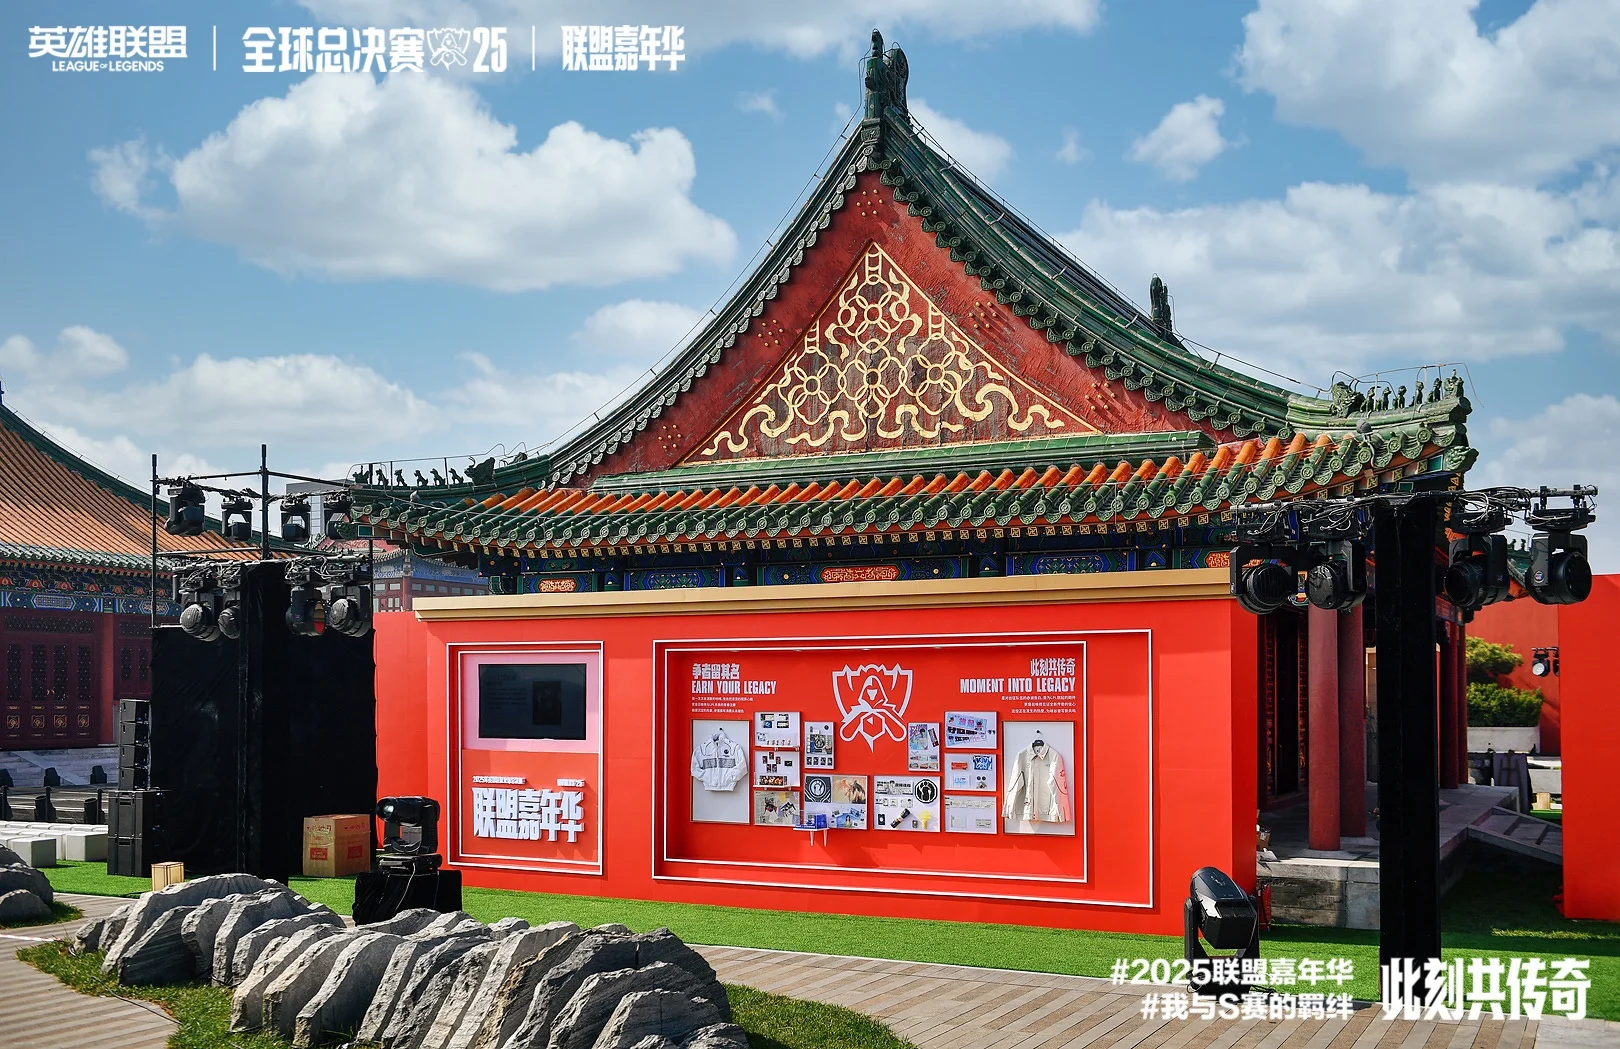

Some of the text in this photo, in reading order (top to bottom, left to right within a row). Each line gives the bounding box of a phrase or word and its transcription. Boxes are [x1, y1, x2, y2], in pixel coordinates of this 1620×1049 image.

[1030, 658, 1076, 677] 此刻共传奇
[691, 680, 777, 695] EARN YOUR LEGACY
[960, 677, 1076, 693] MOMENT INTO LEGACY
[472, 787, 585, 843] 联盟嘉年华
